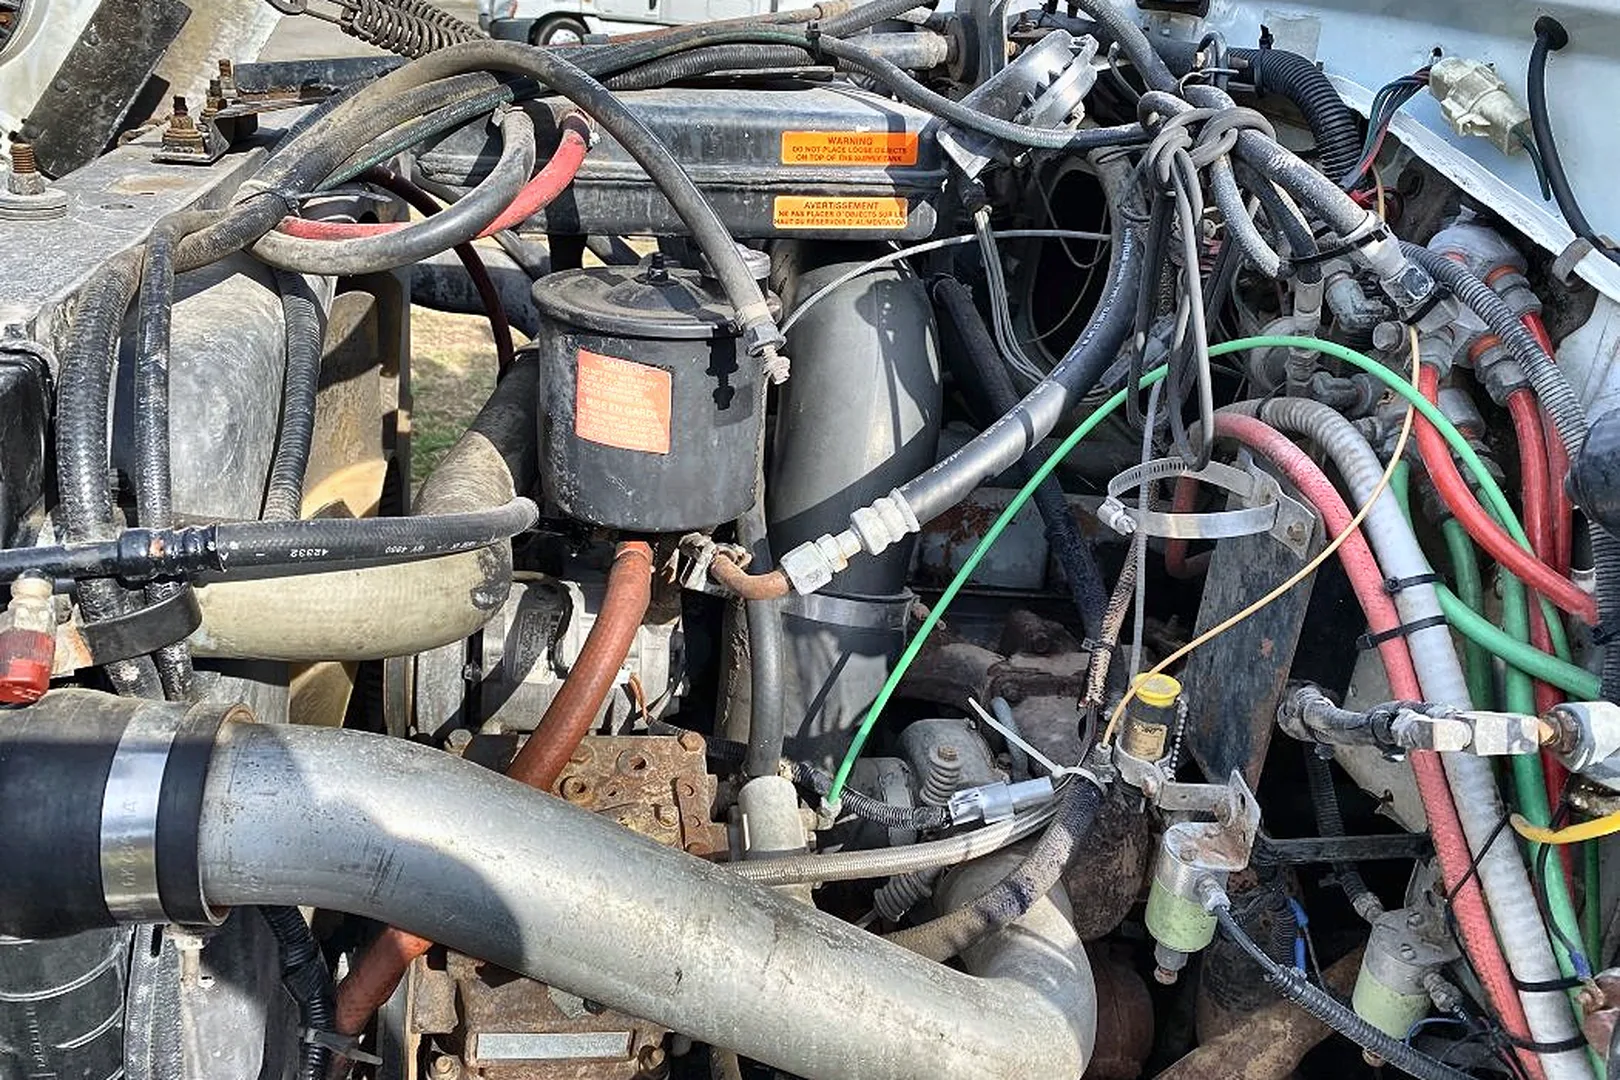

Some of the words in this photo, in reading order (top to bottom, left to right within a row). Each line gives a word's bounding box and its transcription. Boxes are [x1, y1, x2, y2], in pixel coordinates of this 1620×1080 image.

[828, 137, 873, 145] WARNING
[823, 146, 846, 154] PLACE
[874, 147, 906, 155] OBJECTS
[804, 201, 879, 209] AVERTISSEMENT
[602, 360, 645, 376] CAUTION
[289, 548, 330, 558] 42332
